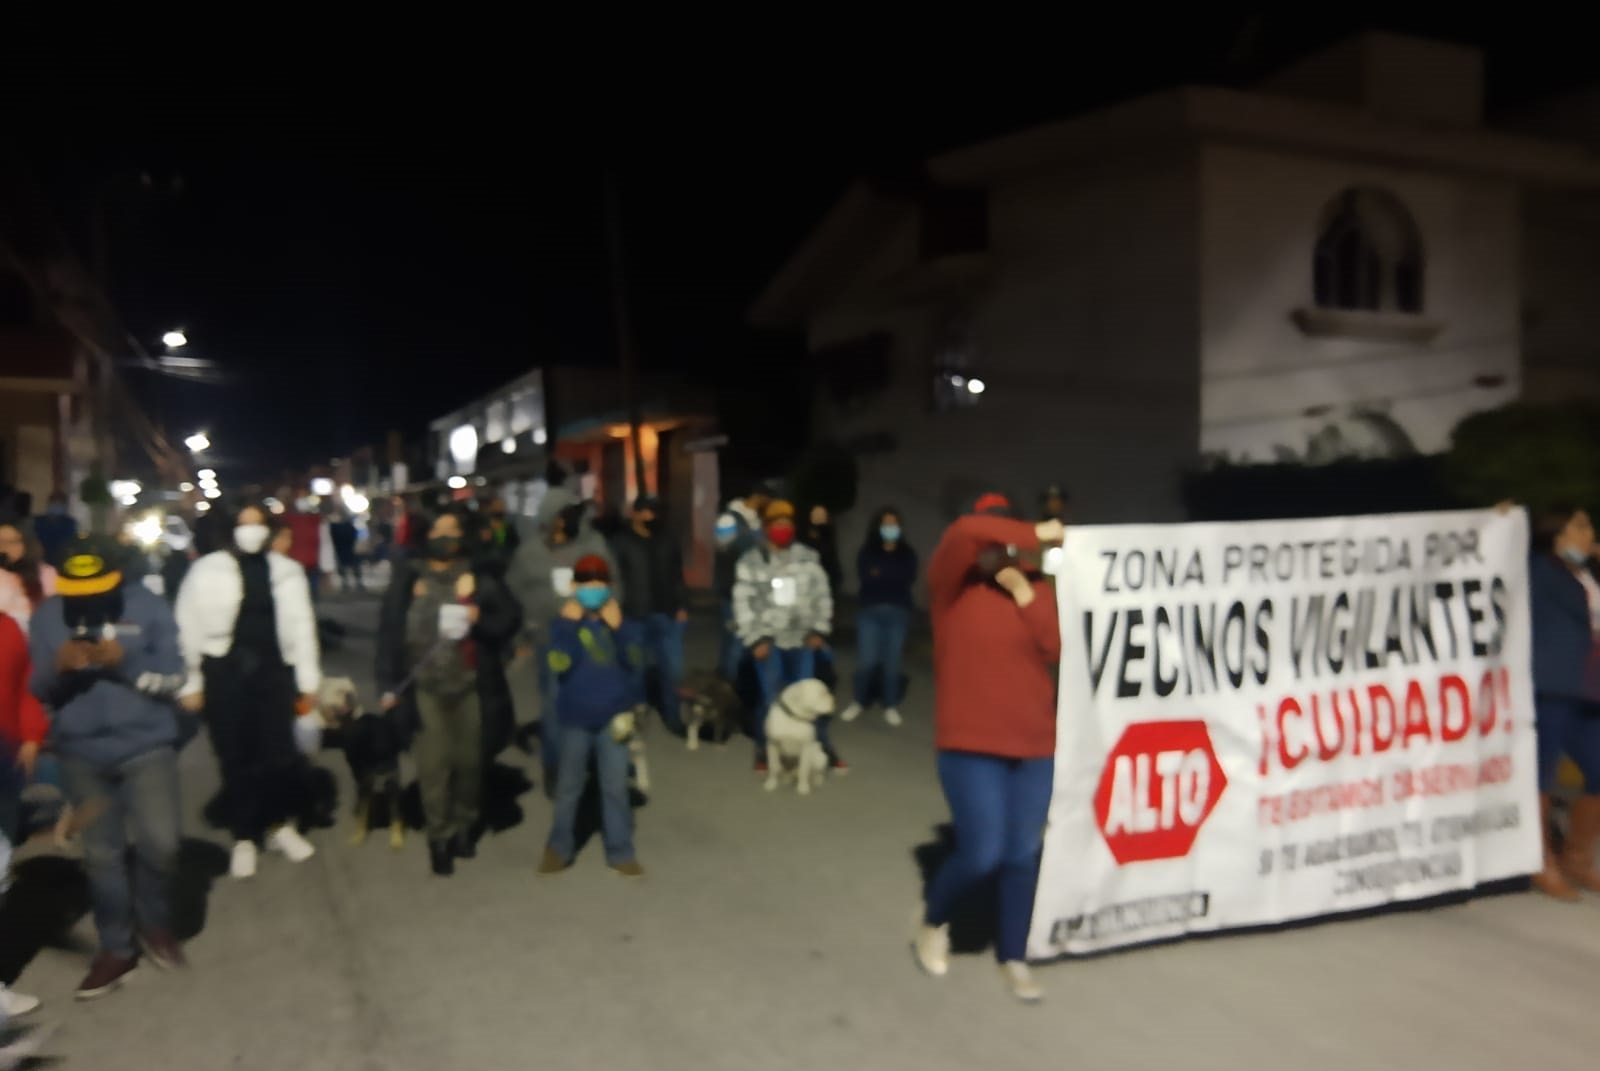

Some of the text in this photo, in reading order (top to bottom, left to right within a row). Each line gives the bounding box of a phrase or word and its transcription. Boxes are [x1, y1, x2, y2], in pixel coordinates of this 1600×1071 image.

[1101, 548, 1205, 592] ZONA
[1222, 535, 1412, 583] PROTEGIDA
[1083, 575, 1507, 699] VECINOS VIGILANTES
[1257, 666, 1513, 776] ¡CUIDADO!
[1104, 748, 1211, 836] ALTO
